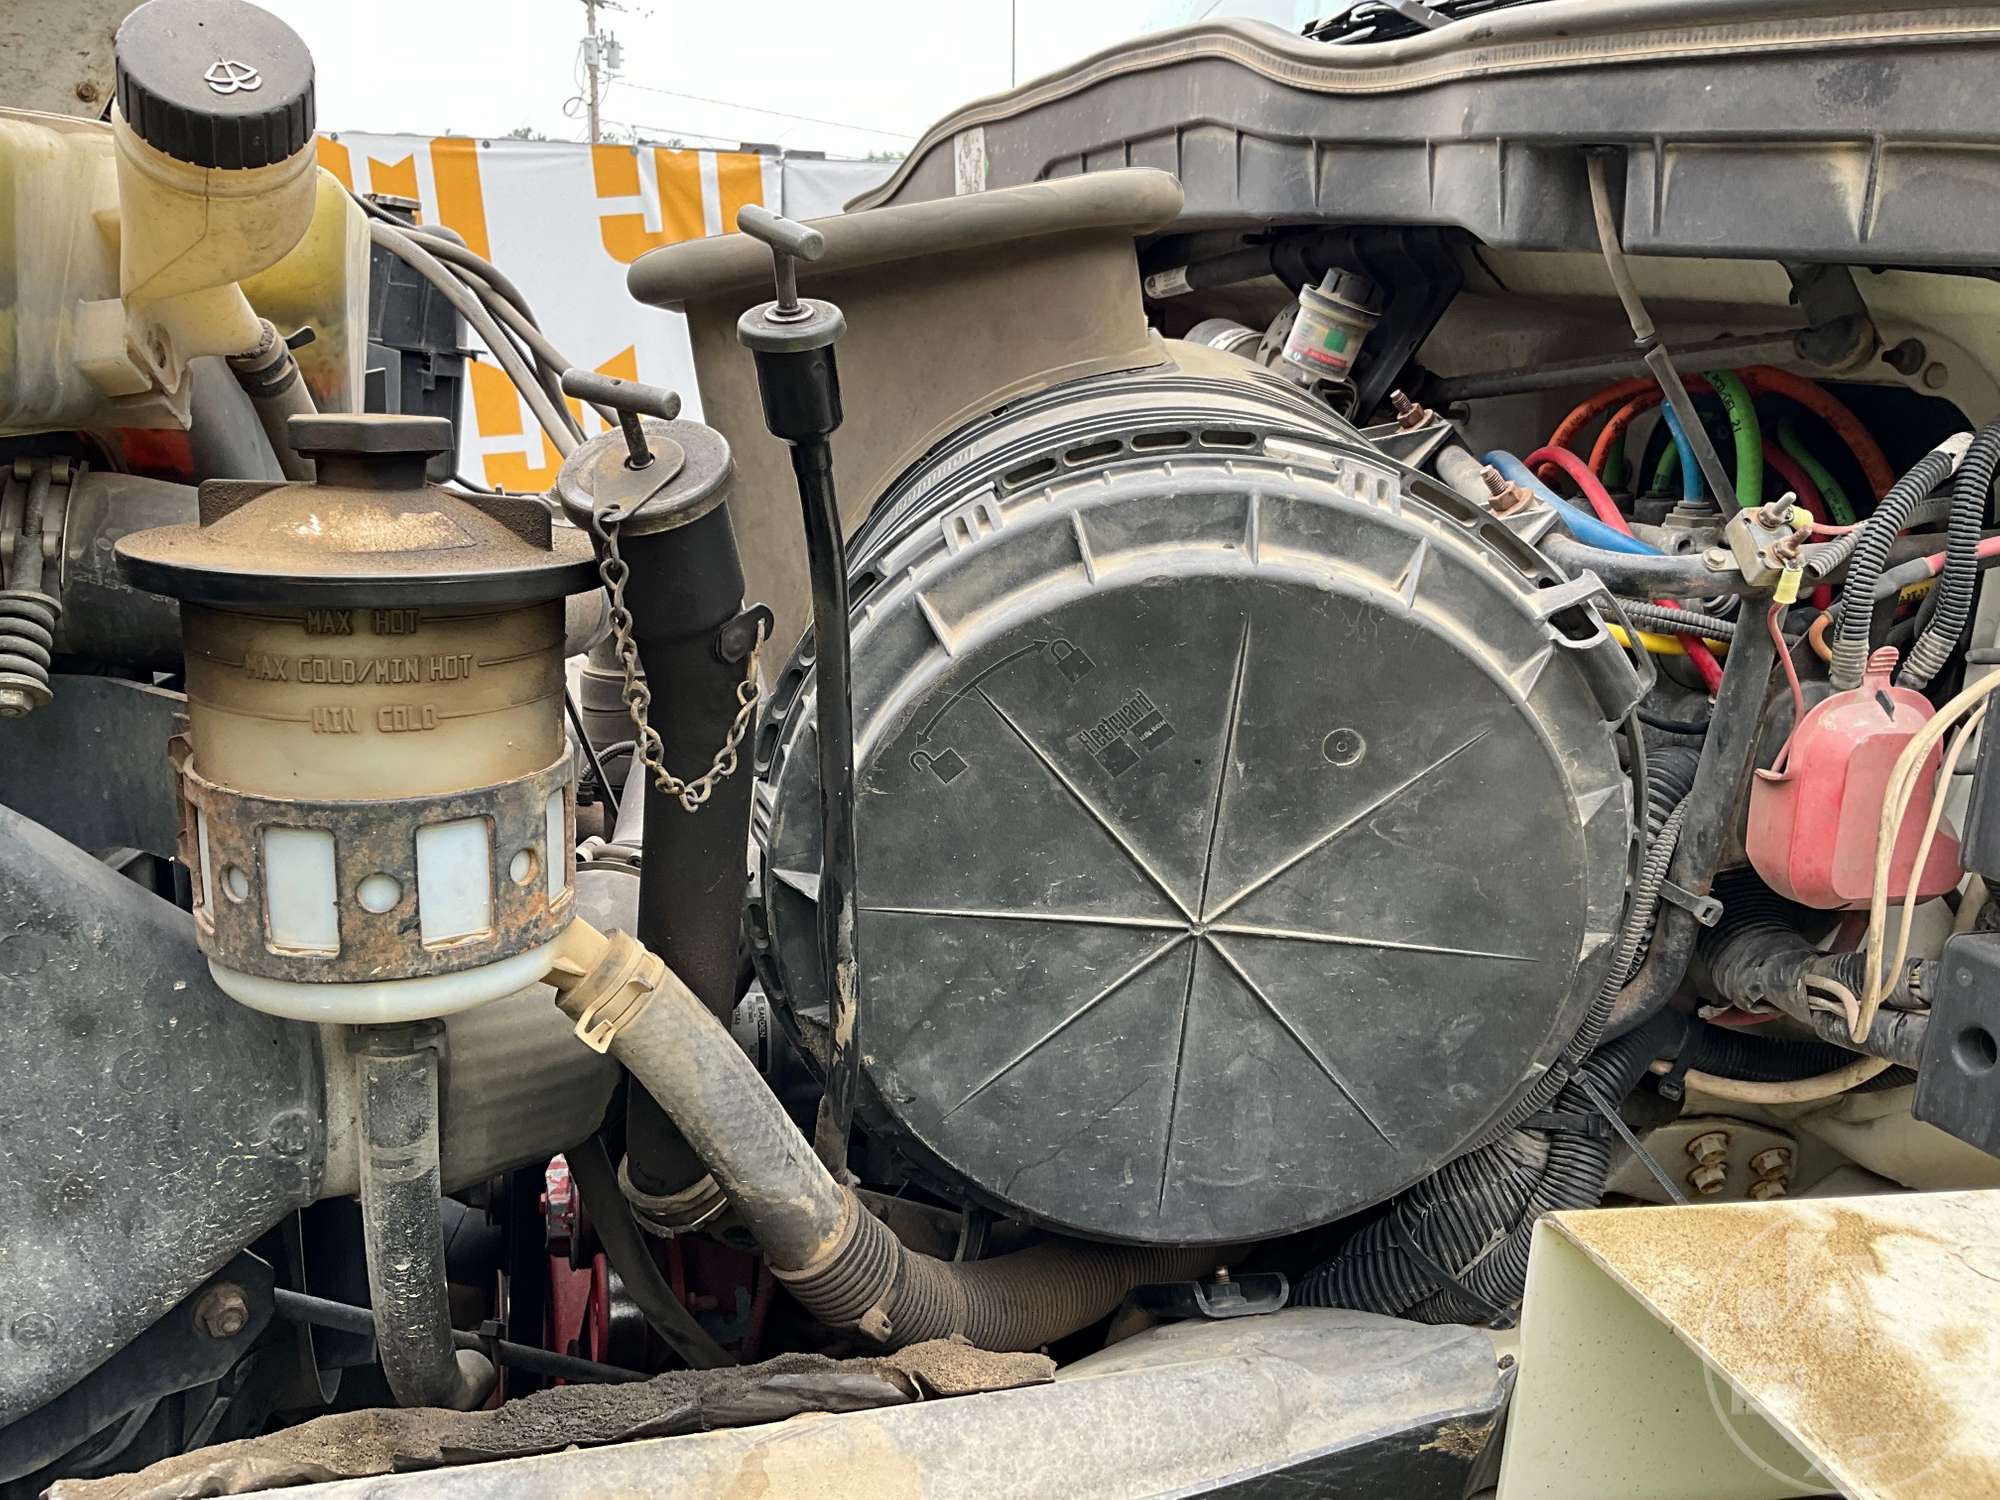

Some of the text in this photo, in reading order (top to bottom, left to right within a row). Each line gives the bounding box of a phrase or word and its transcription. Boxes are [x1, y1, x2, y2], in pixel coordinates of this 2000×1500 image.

[305, 609, 421, 636] MAX HOT
[245, 653, 474, 685] MAX COLD/MIN HOT
[311, 704, 437, 735] MIN COLD
[1078, 688, 1157, 756] Fleetguard
